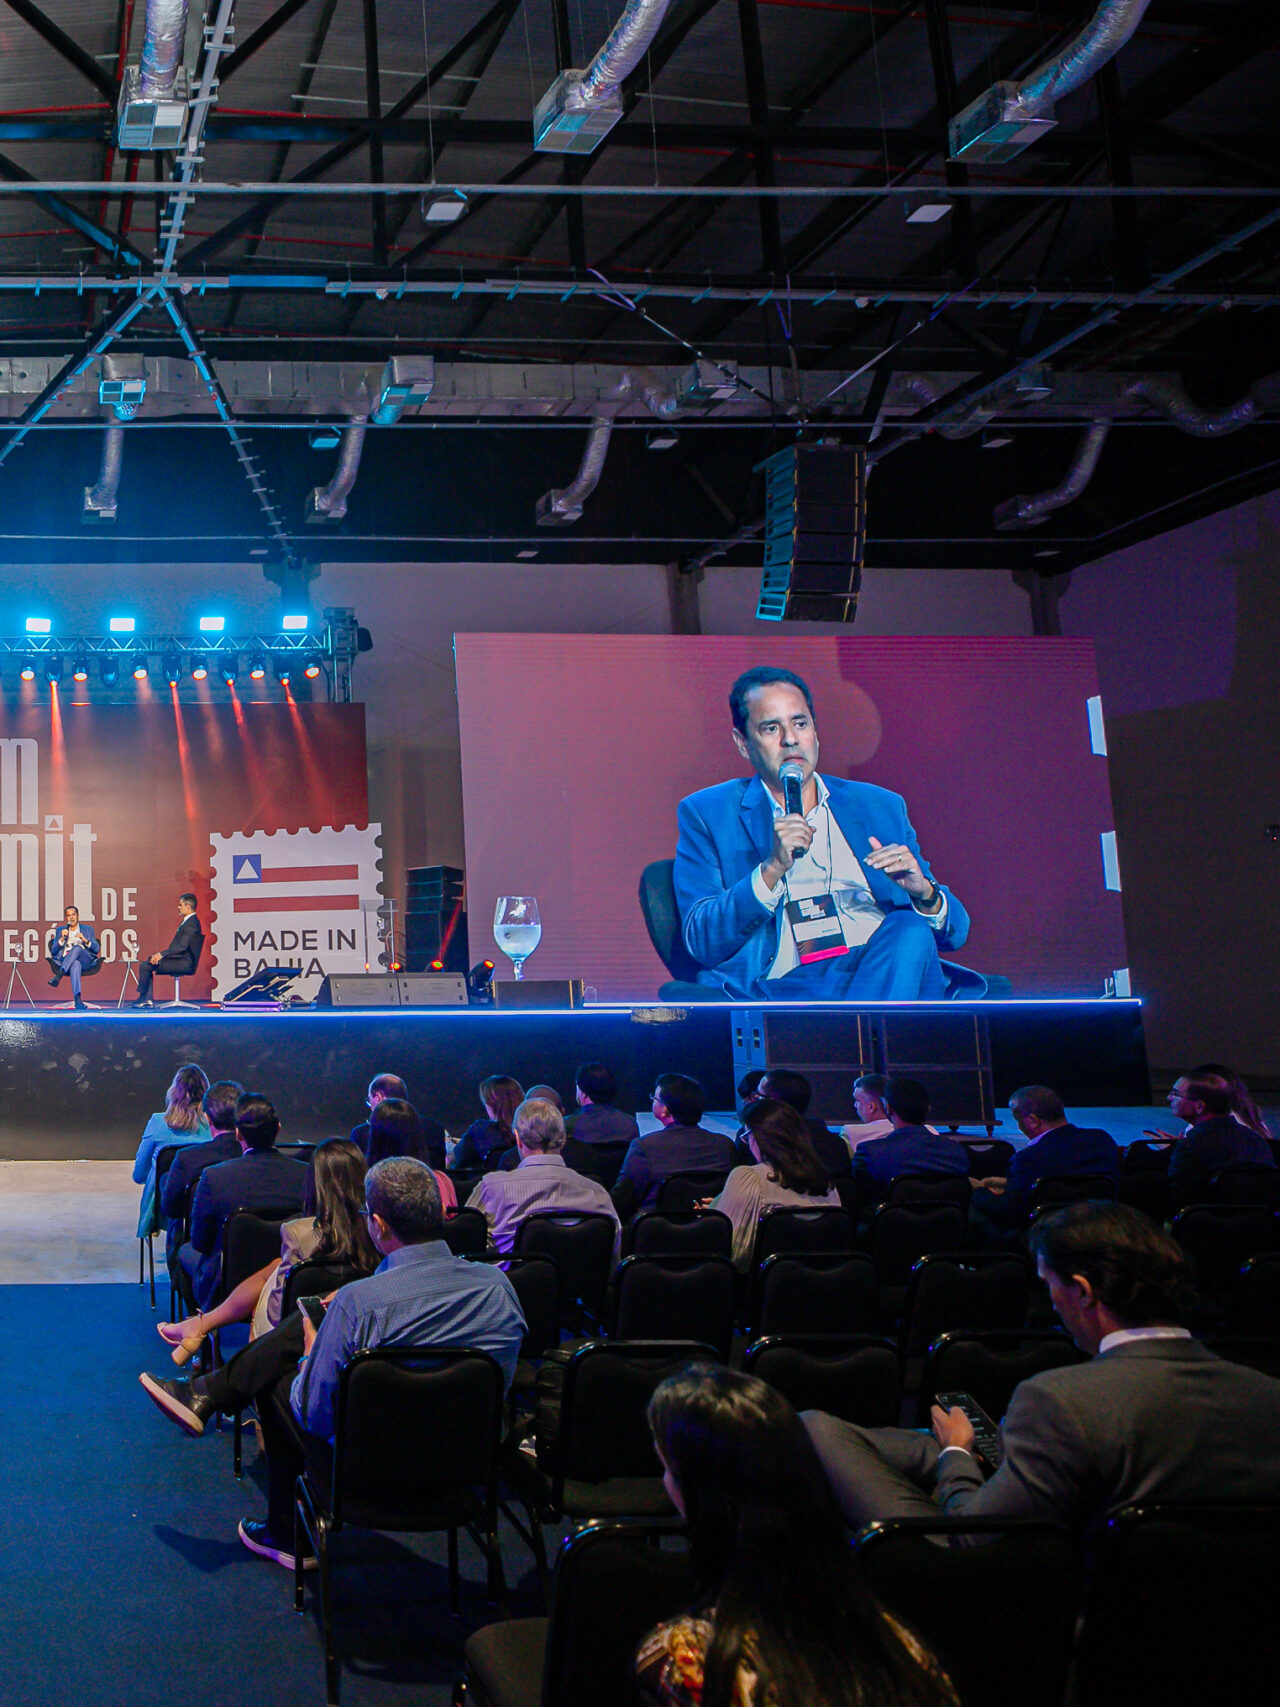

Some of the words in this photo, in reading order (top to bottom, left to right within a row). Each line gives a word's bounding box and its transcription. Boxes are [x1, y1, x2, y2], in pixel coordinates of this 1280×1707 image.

[101, 887, 138, 921] DE
[234, 929, 318, 952] MADE
[328, 929, 356, 951] IN
